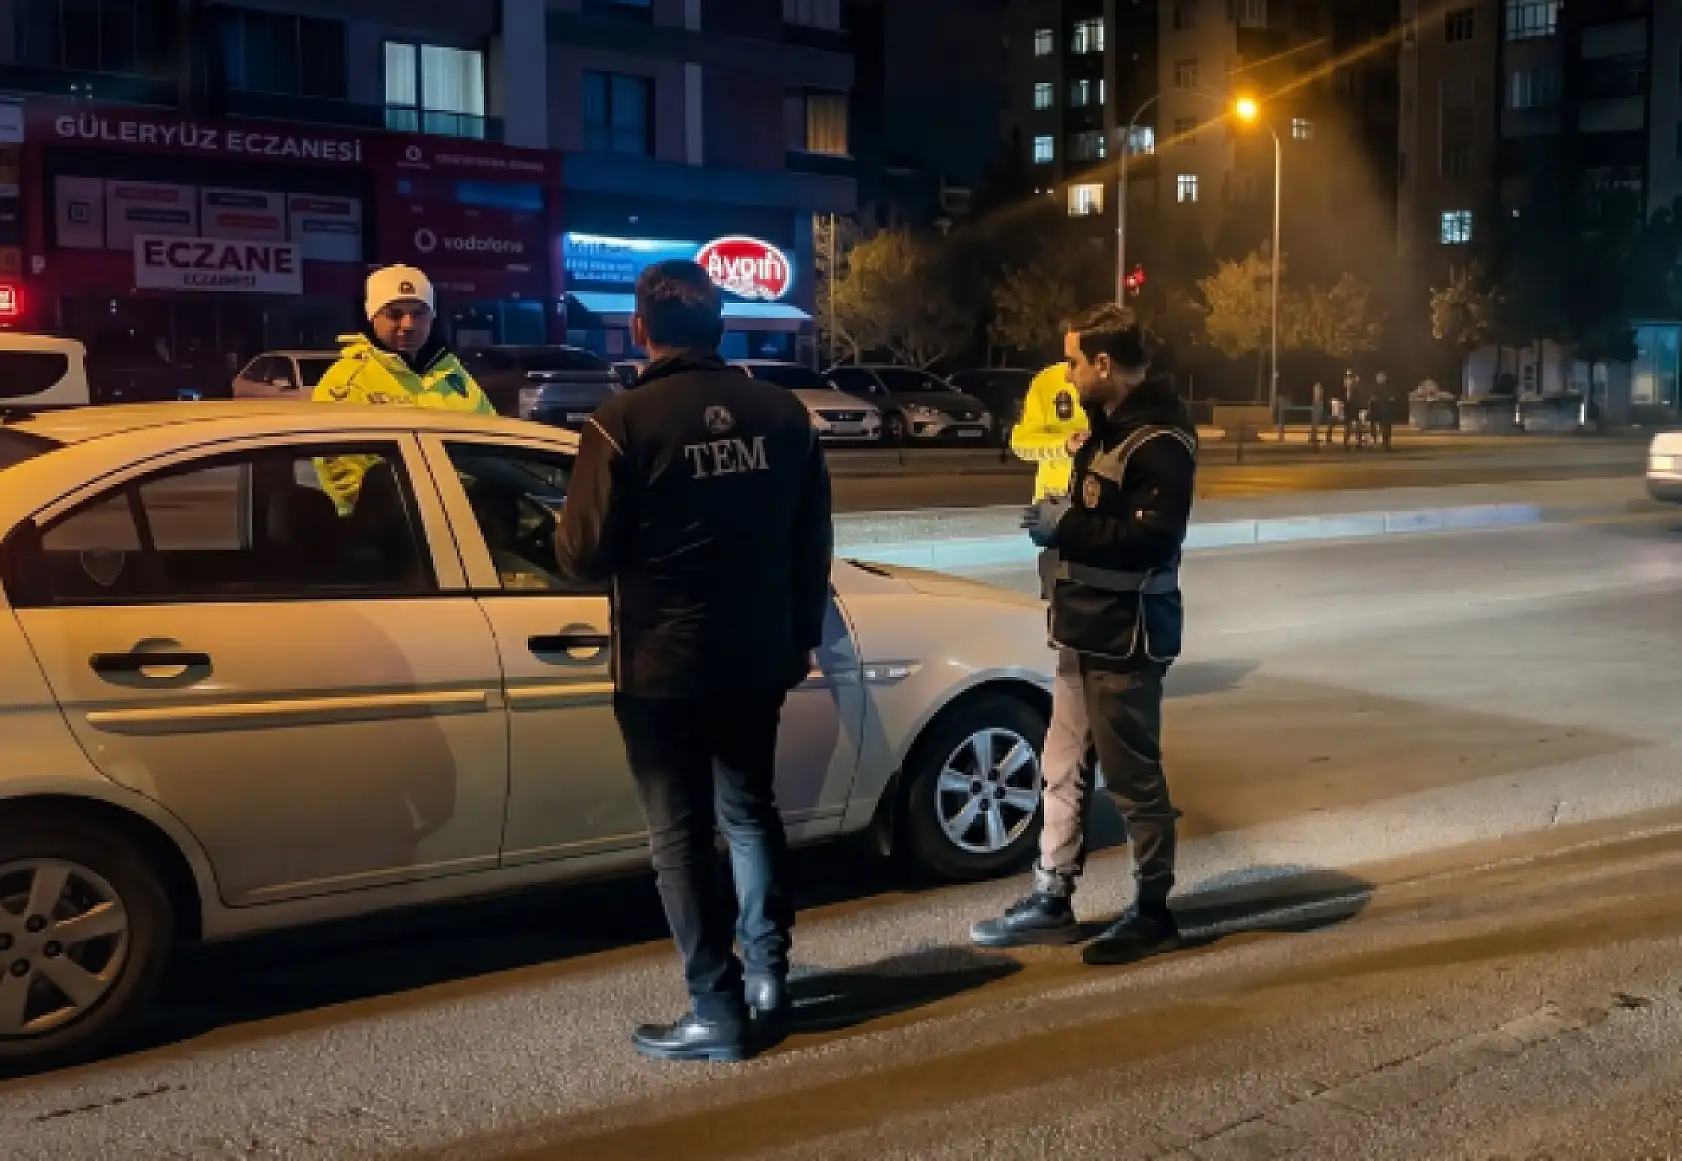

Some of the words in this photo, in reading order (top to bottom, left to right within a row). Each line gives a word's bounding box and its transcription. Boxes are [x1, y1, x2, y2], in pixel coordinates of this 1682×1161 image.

[55, 112, 218, 150] GÜLERYÜZ
[226, 134, 363, 161] ECZANESİ
[144, 240, 294, 273] ECZANE
[683, 436, 770, 480] TEM
